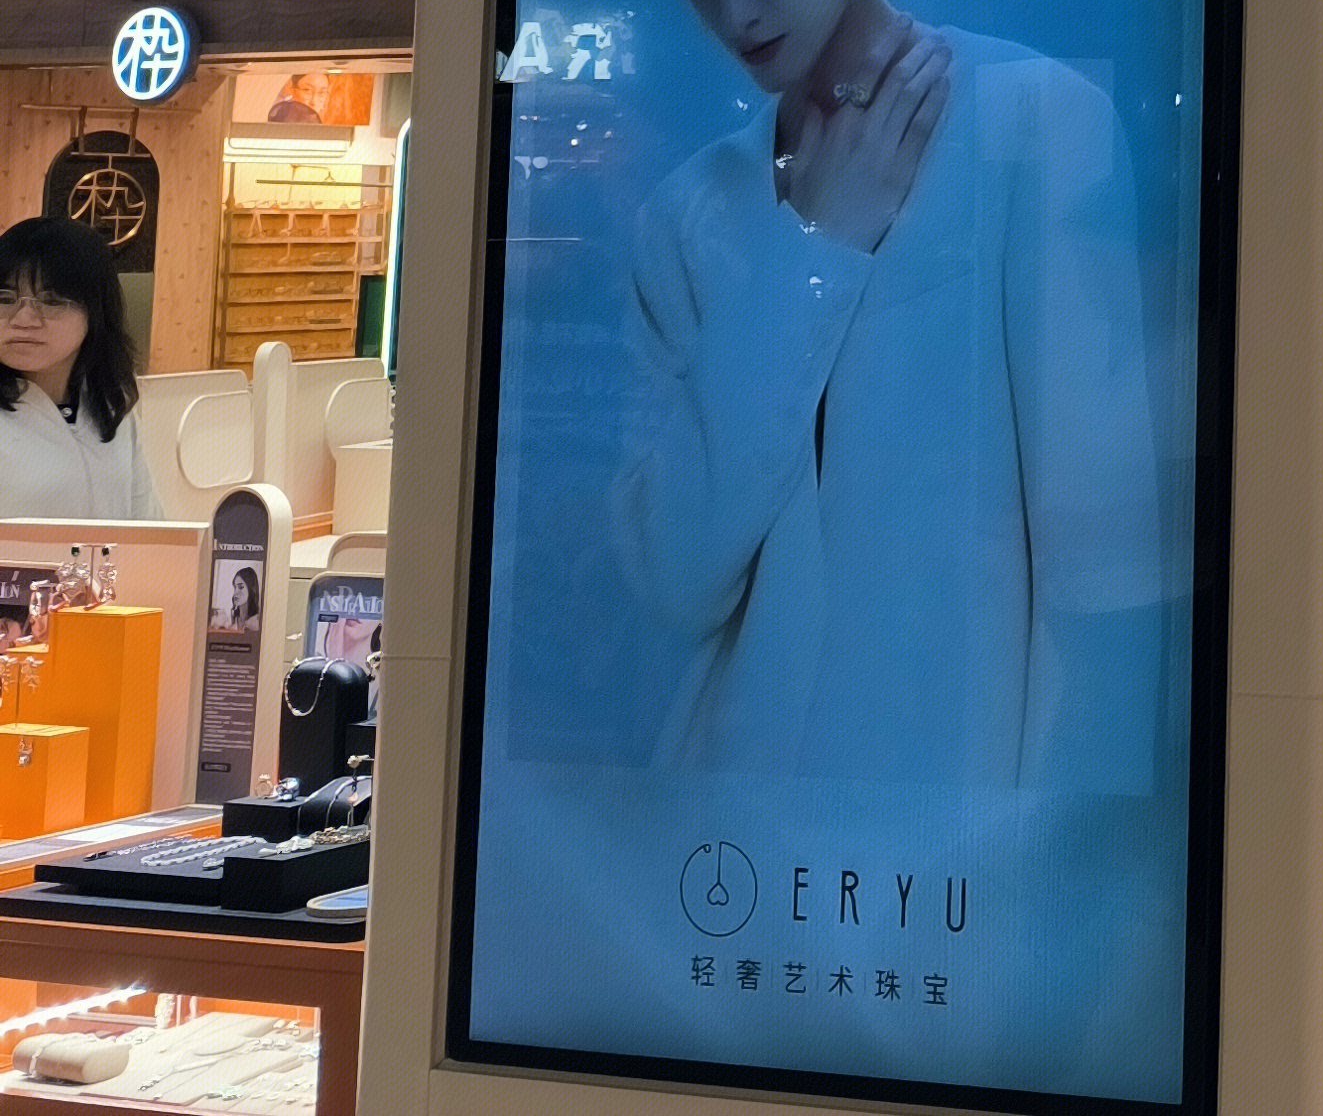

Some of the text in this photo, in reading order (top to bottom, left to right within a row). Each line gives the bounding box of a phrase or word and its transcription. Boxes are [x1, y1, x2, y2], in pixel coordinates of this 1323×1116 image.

[792, 867, 967, 933] ERYU
[690, 955, 949, 1006] 轻奢艺术珠宝
